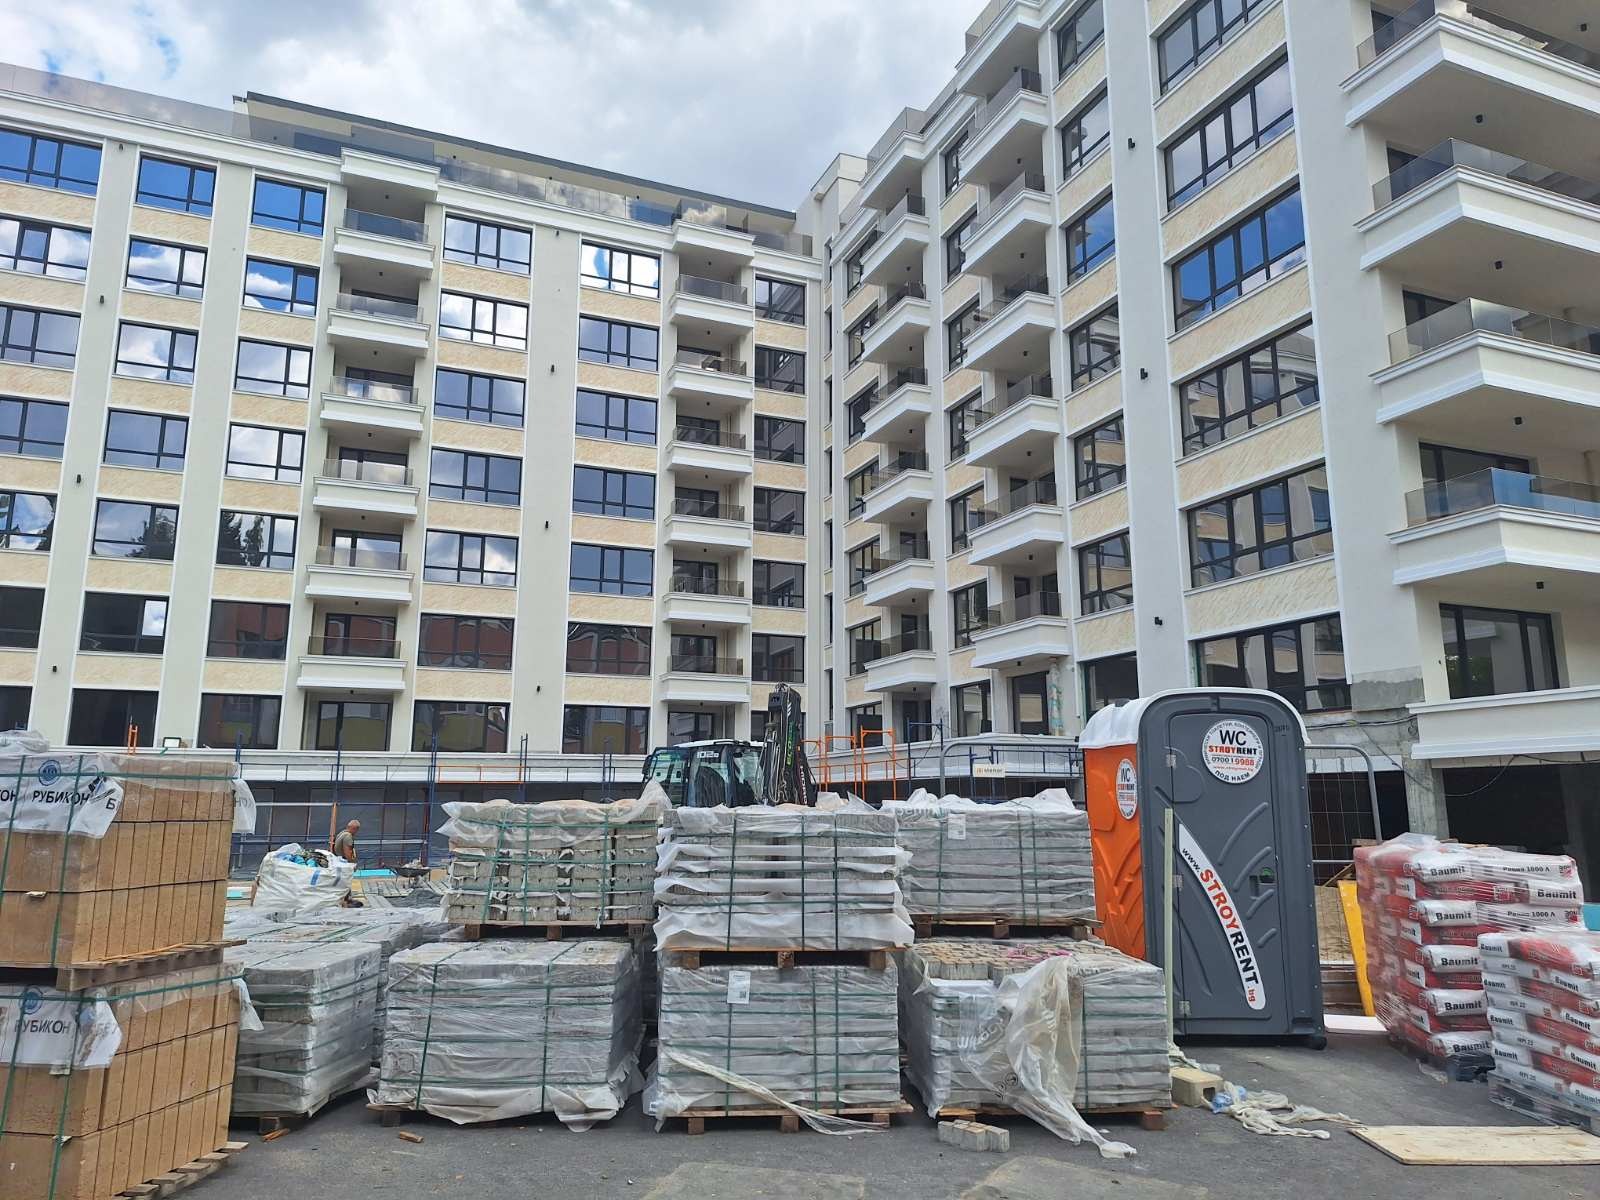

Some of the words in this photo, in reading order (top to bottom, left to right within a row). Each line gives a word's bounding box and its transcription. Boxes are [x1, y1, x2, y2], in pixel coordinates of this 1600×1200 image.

[1219, 729, 1247, 745] WC
[1208, 745, 1257, 755] STROYRENT
[1215, 770, 1230, 781] ПОД
[1231, 772, 1251, 781] НАЕМ
[32, 789, 91, 806] РУБИКОН
[1431, 865, 1466, 876] Baumit
[1537, 888, 1577, 900] Baumit
[1435, 911, 1472, 921] Baumit
[1480, 943, 1503, 953] Baumit
[1441, 957, 1478, 967] Baumit
[1444, 1000, 1482, 1011] Baumit
[1565, 1012, 1591, 1031] Baumit
[1453, 1041, 1491, 1053] Baumit
[1494, 1048, 1518, 1061] Baumit
[1570, 1051, 1597, 1070] Baumit
